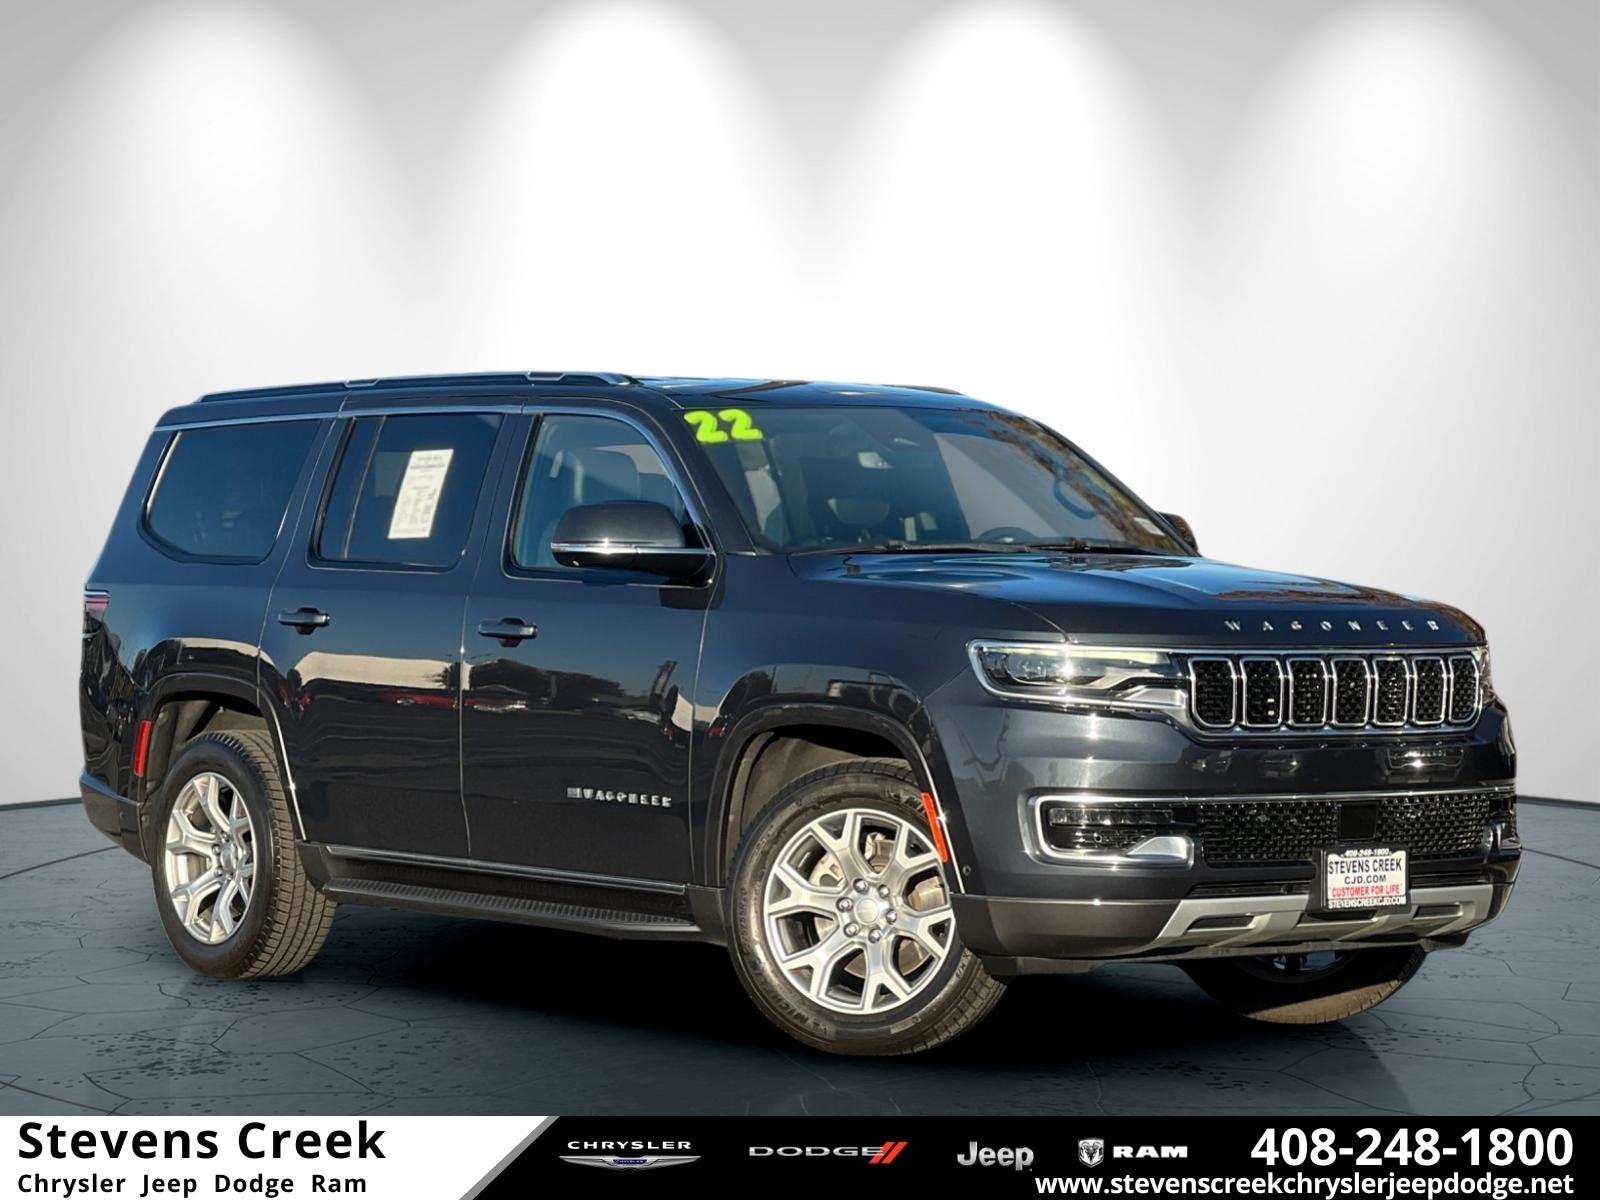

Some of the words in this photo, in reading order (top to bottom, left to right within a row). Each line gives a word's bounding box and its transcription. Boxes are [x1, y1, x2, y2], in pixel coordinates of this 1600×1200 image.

[683, 408, 763, 443] 22
[1224, 619, 1440, 632] WAGONEER
[582, 788, 672, 808] WAGONEER
[1328, 859, 1370, 874] STEVENS
[1372, 858, 1402, 872] CREEK
[1344, 874, 1387, 884] CJD.COM
[1371, 885, 1384, 896] FOR
